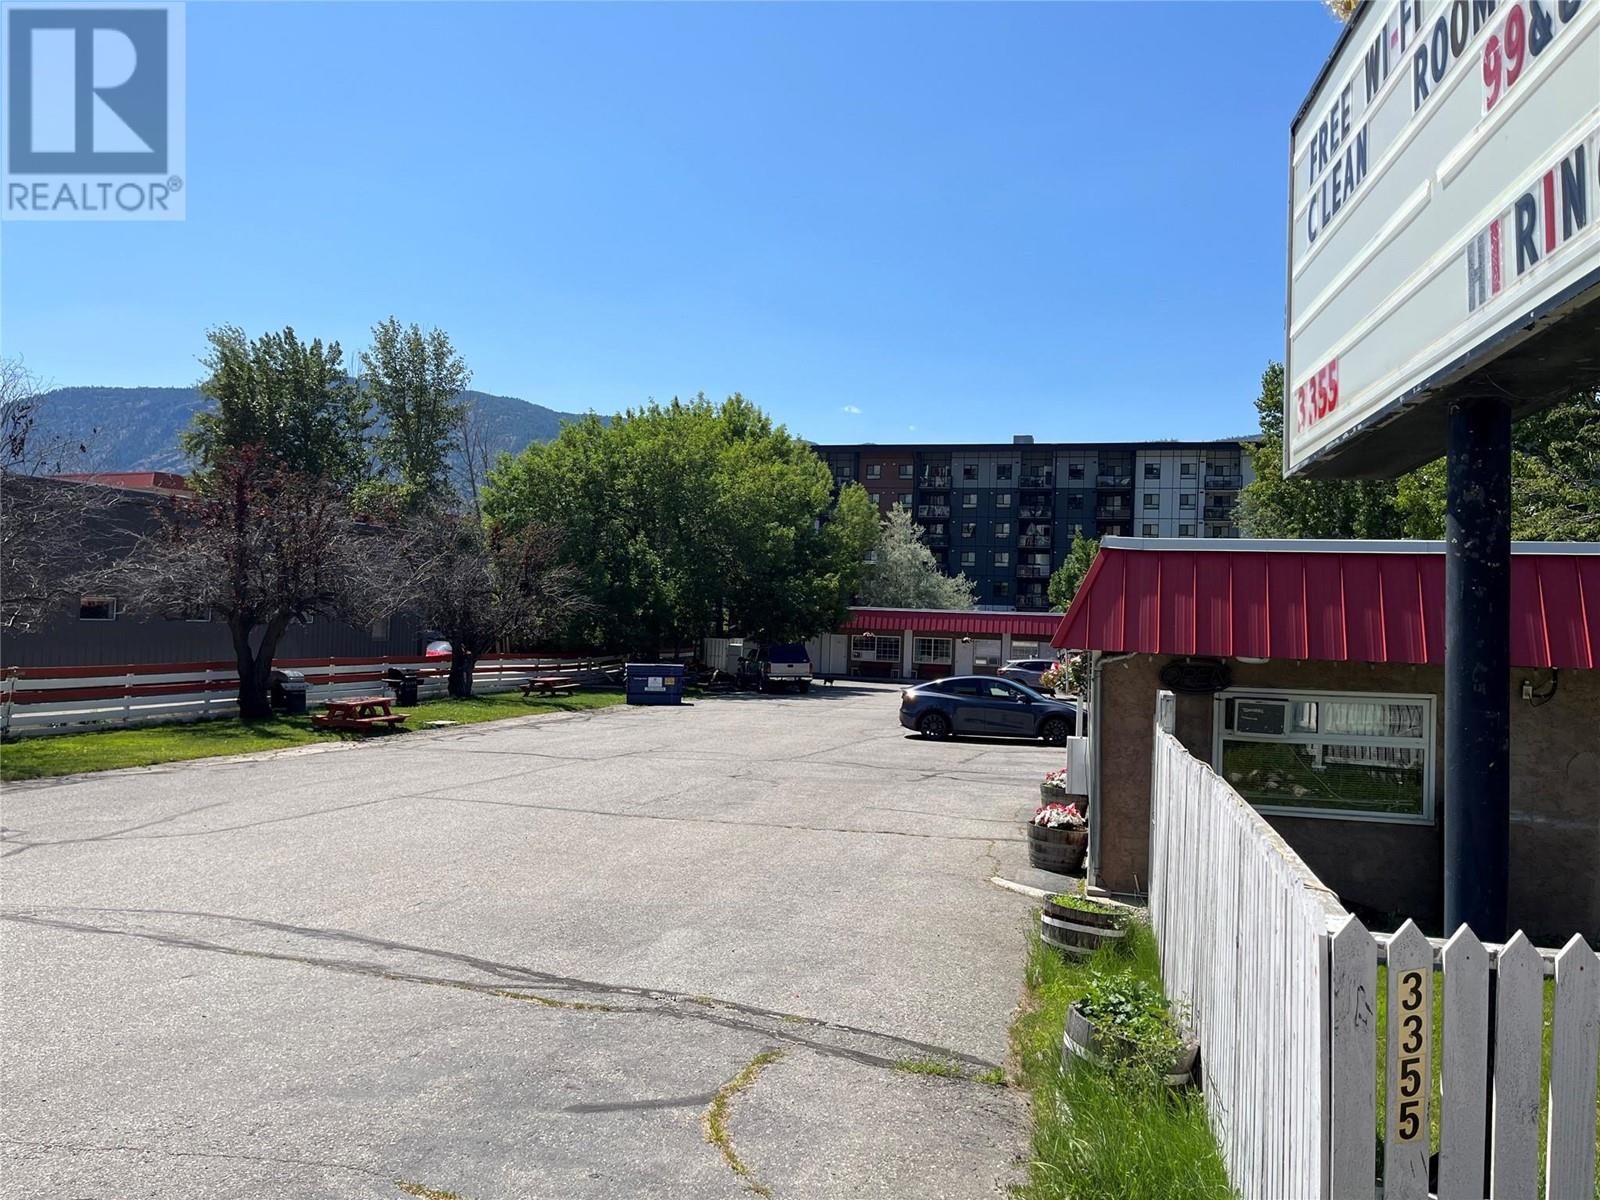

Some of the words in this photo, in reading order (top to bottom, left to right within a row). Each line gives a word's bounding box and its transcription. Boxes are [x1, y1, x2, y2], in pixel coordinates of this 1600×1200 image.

[1309, 82, 1352, 187] FREE
[1363, 0, 1421, 105] WI-FI
[1307, 123, 1368, 244] CLEAN
[1466, 143, 1600, 313] HIRIN
[1398, 971, 1423, 1141] 3355
